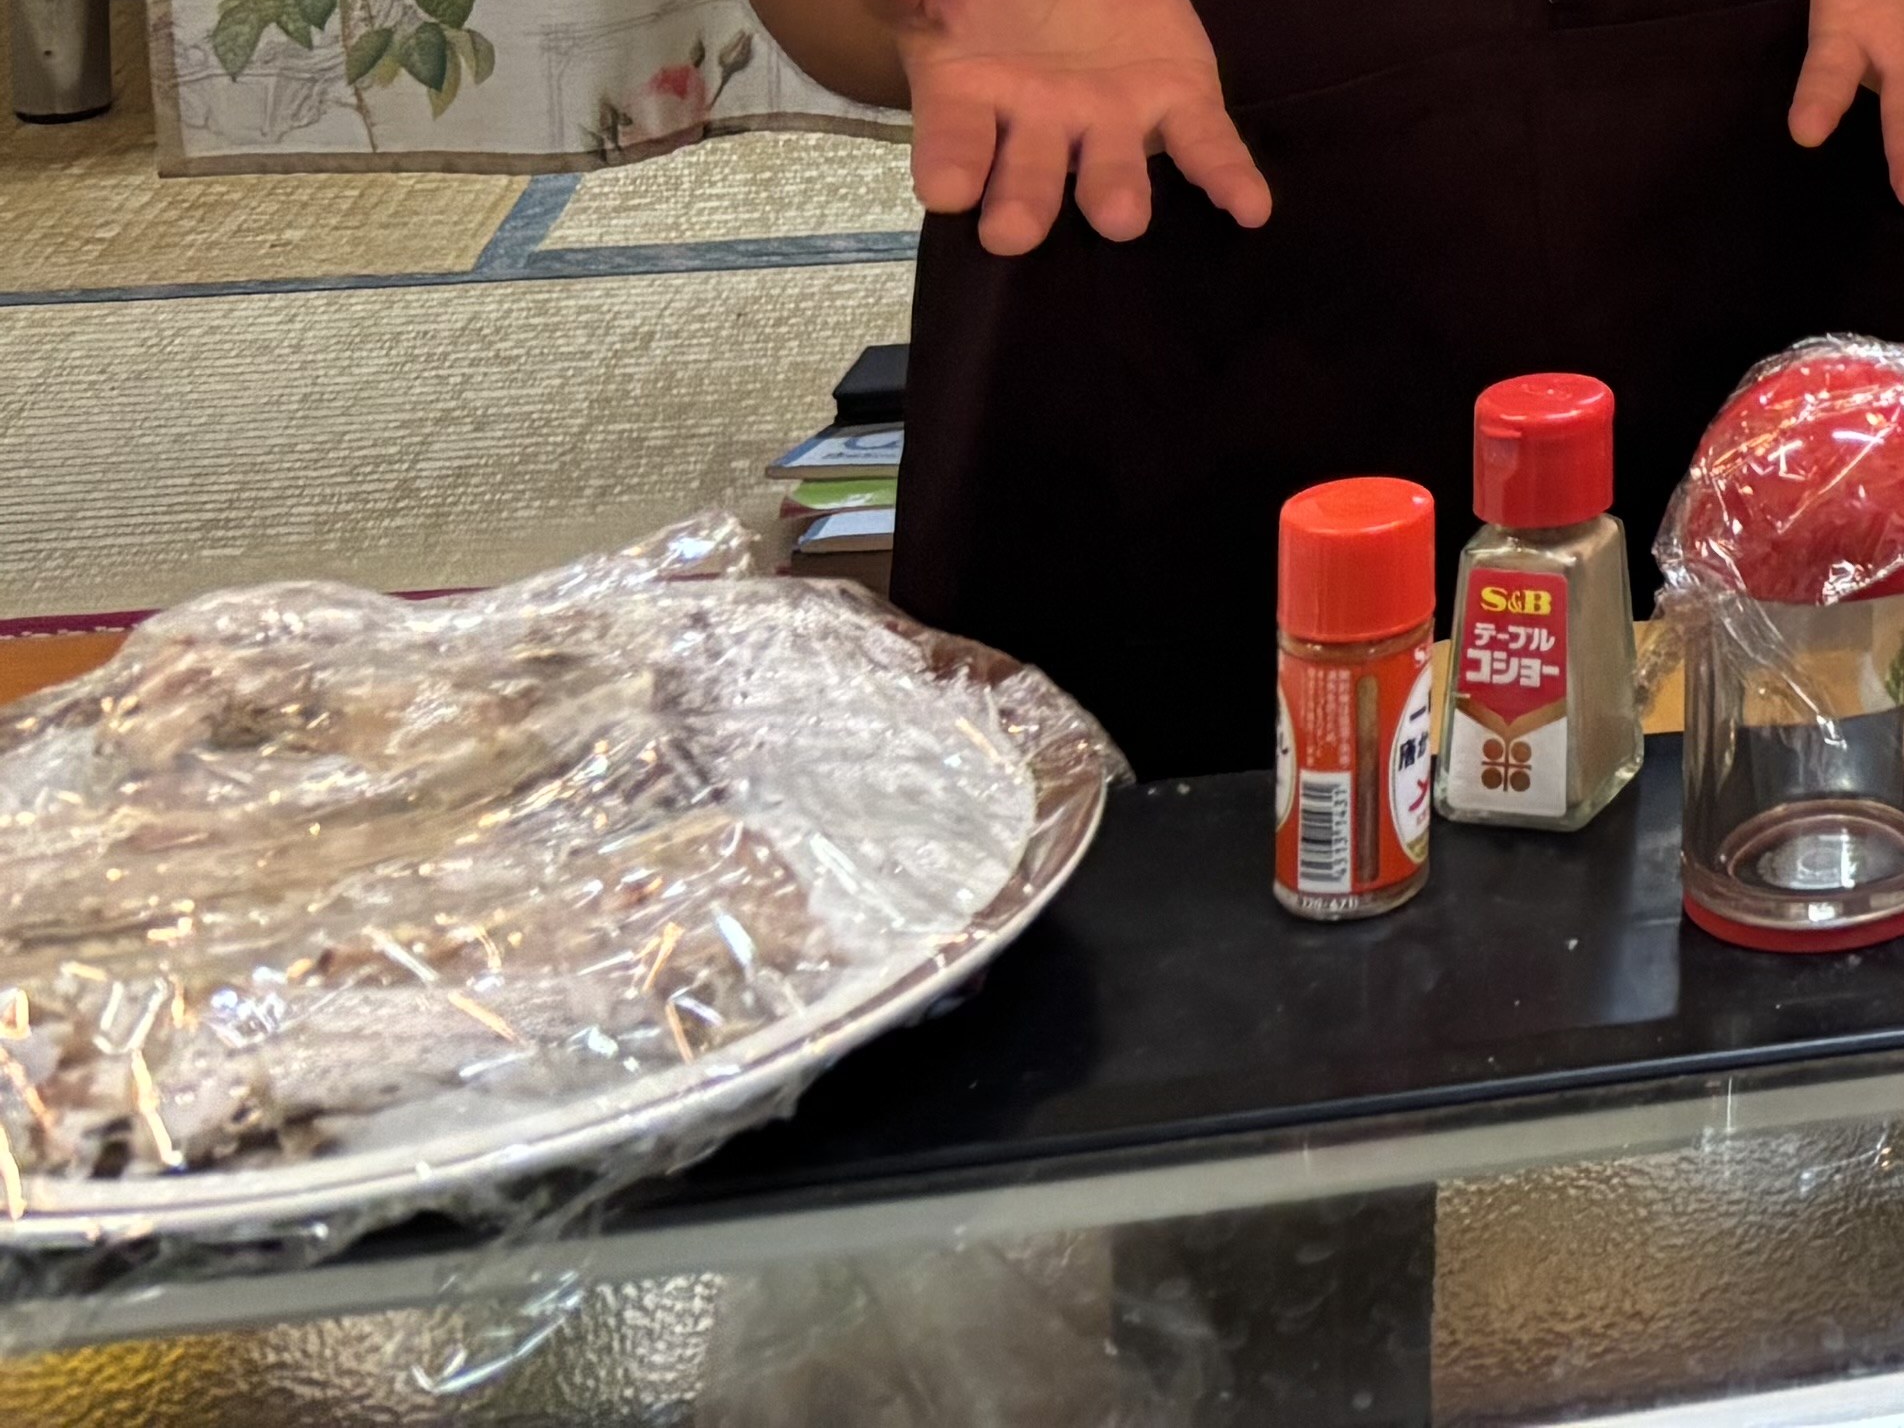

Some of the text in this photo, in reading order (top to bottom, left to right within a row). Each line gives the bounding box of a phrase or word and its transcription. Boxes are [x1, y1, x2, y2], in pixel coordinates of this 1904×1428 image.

[1480, 586, 1553, 616] S&B
[1474, 622, 1556, 652] テーブル
[1465, 647, 1561, 688] コショー
